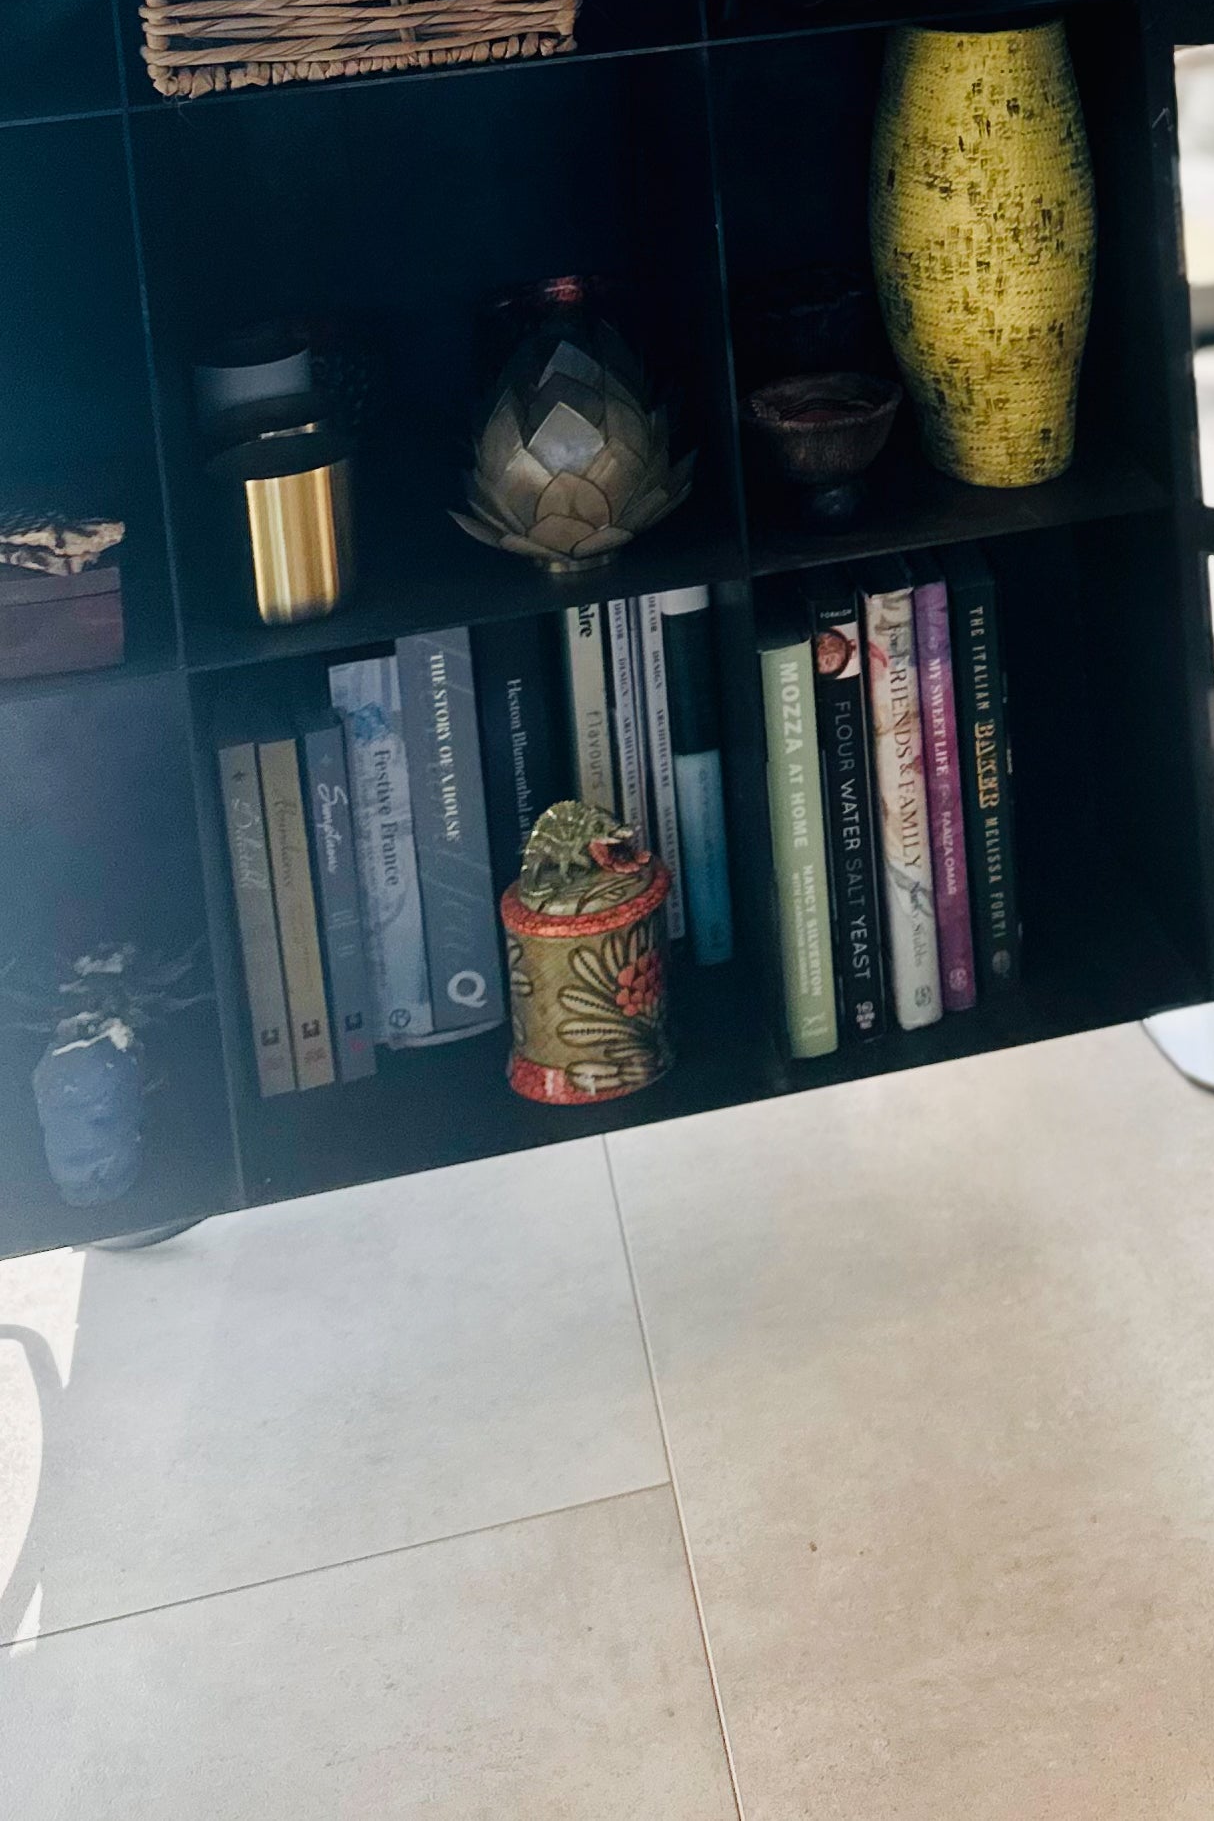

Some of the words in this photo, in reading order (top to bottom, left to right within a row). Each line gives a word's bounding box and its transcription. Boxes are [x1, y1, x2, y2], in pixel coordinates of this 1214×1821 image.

[968, 605, 984, 637] THE
[429, 651, 449, 686] THE
[928, 658, 943, 680] MY
[971, 645, 991, 711] ITALIAN
[432, 688, 453, 741] STORY
[506, 678, 523, 731] Heston
[779, 661, 803, 754] MOZZA
[888, 652, 914, 758] FRIENDS
[929, 684, 946, 738] SWEET
[437, 745, 455, 765] OF
[586, 710, 606, 789] flavours
[834, 700, 855, 772] FLOUR
[933, 742, 949, 776] LIFE
[374, 749, 395, 816] Festive
[511, 731, 534, 814] Blumenthal
[788, 763, 805, 784] AT
[898, 763, 912, 777] &
[974, 720, 1001, 809] BAKER
[442, 785, 461, 842] HOUSE
[790, 792, 809, 848] HOME
[840, 779, 860, 851] WATER
[897, 781, 922, 870] FAMILY
[380, 821, 400, 886] France
[944, 858, 957, 896] OMAR
[984, 817, 1003, 884] MELISSA
[803, 864, 817, 913] NANCY
[845, 859, 866, 907] SALT
[990, 892, 1007, 940] FORTI
[805, 918, 823, 997] SILVERTON
[850, 915, 871, 980] YEAST
